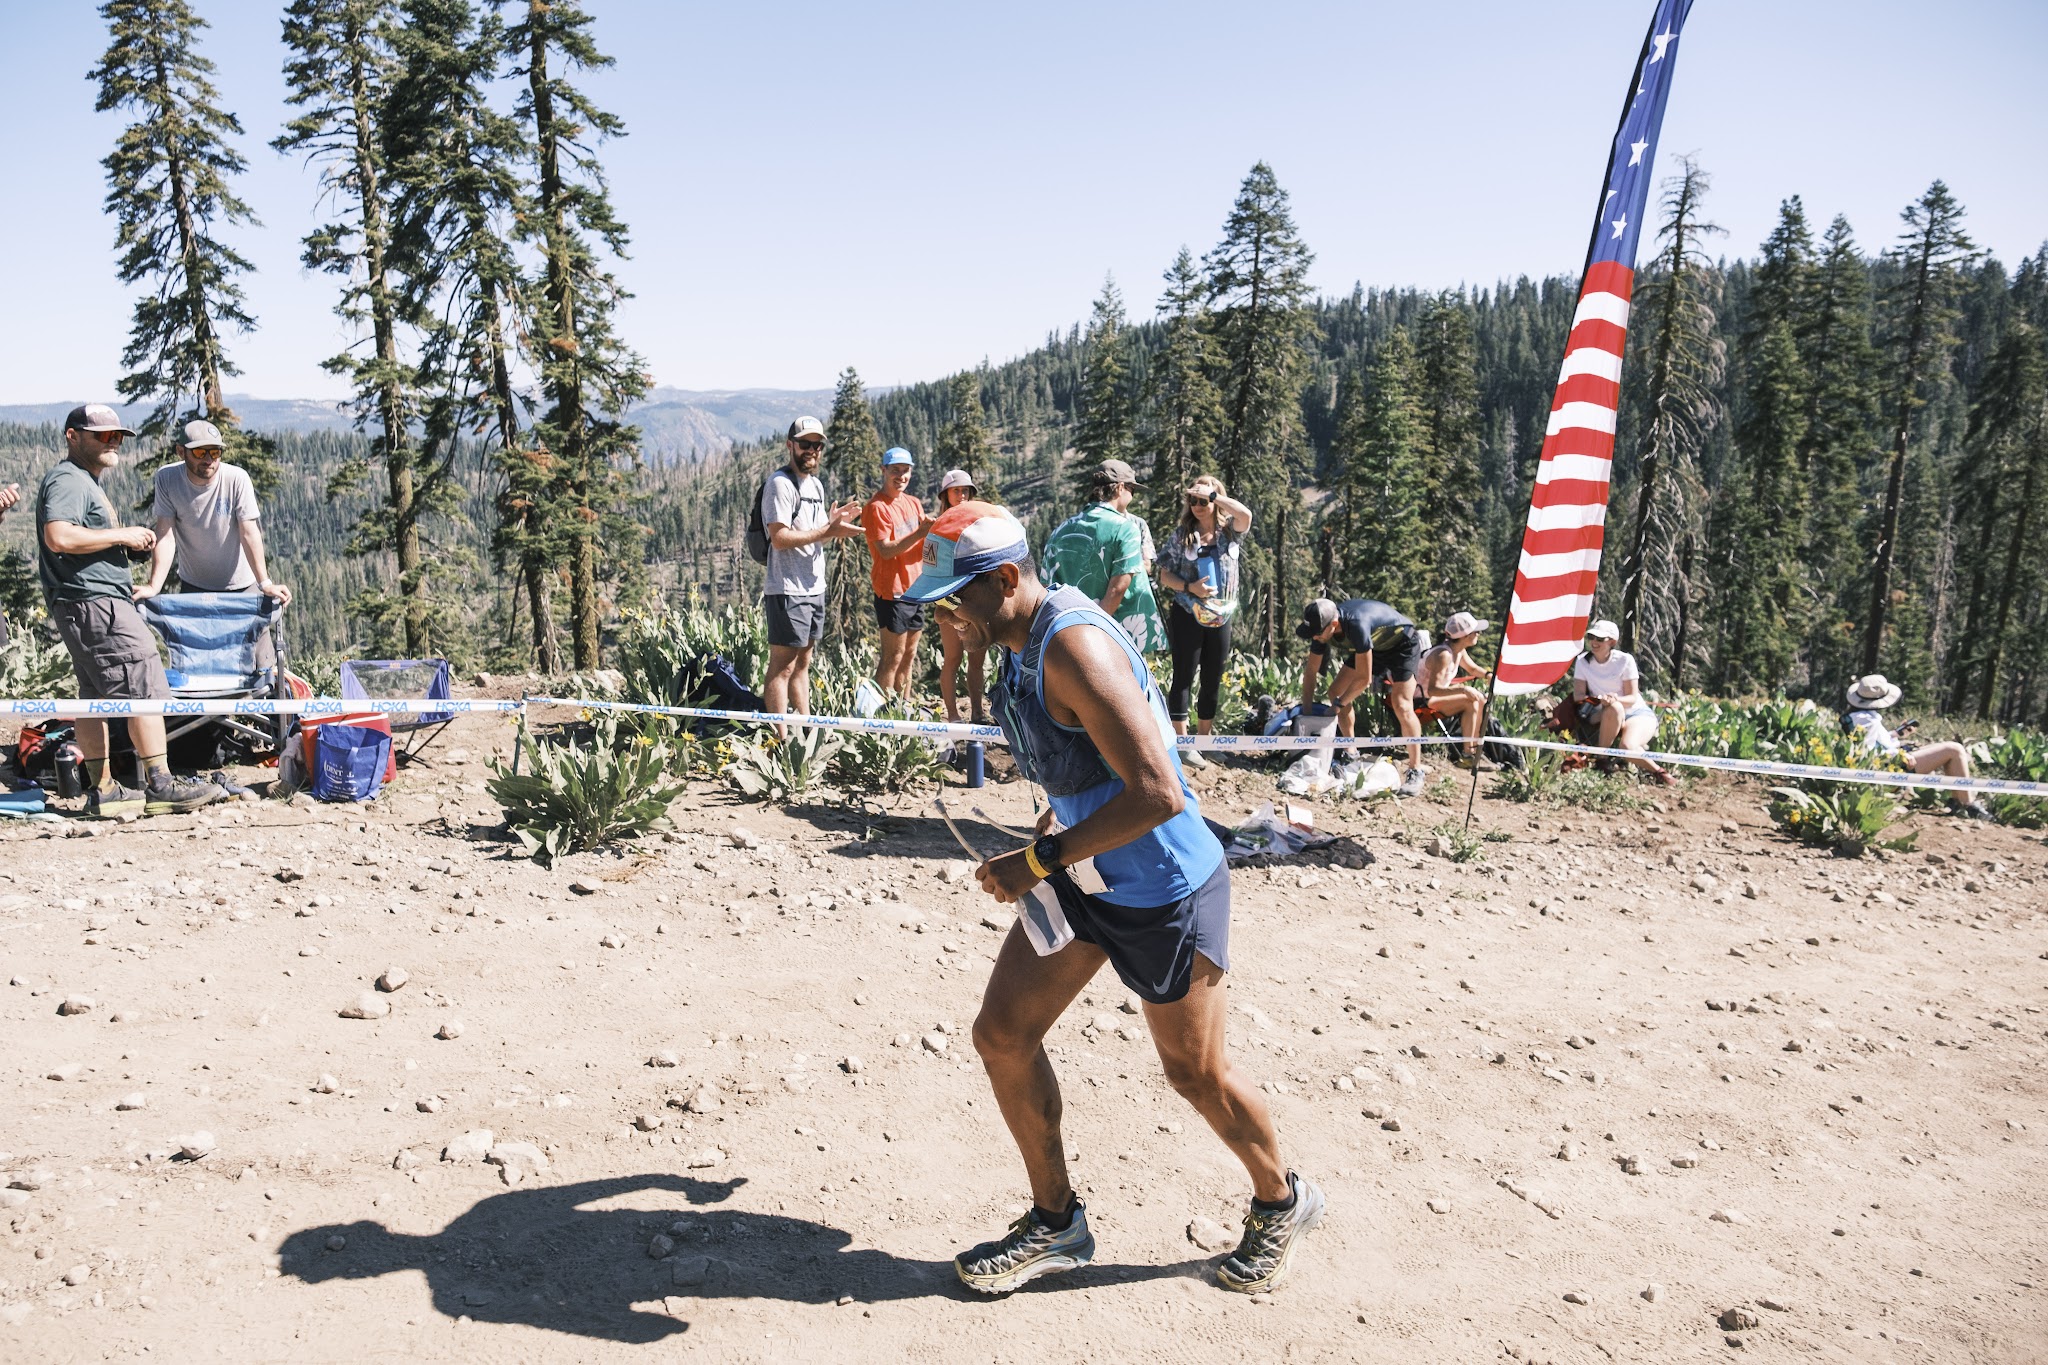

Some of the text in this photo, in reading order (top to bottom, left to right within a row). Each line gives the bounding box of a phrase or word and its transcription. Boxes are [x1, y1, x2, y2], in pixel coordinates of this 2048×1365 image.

[12, 701, 57, 713] HOKA
[88, 701, 132, 713] HOKA
[163, 701, 206, 713] HOKA
[234, 702, 275, 713] HOKA
[304, 702, 343, 713] HOKA
[371, 702, 408, 713] HOKA
[435, 702, 471, 712] HOKA
[807, 716, 840, 725] HOKA
[862, 719, 895, 729] HOKA
[917, 723, 948, 733] HOKA
[970, 726, 1001, 737] HOKA
[1212, 736, 1238, 744] HOKA
[326, 764, 355, 778] DENTL
